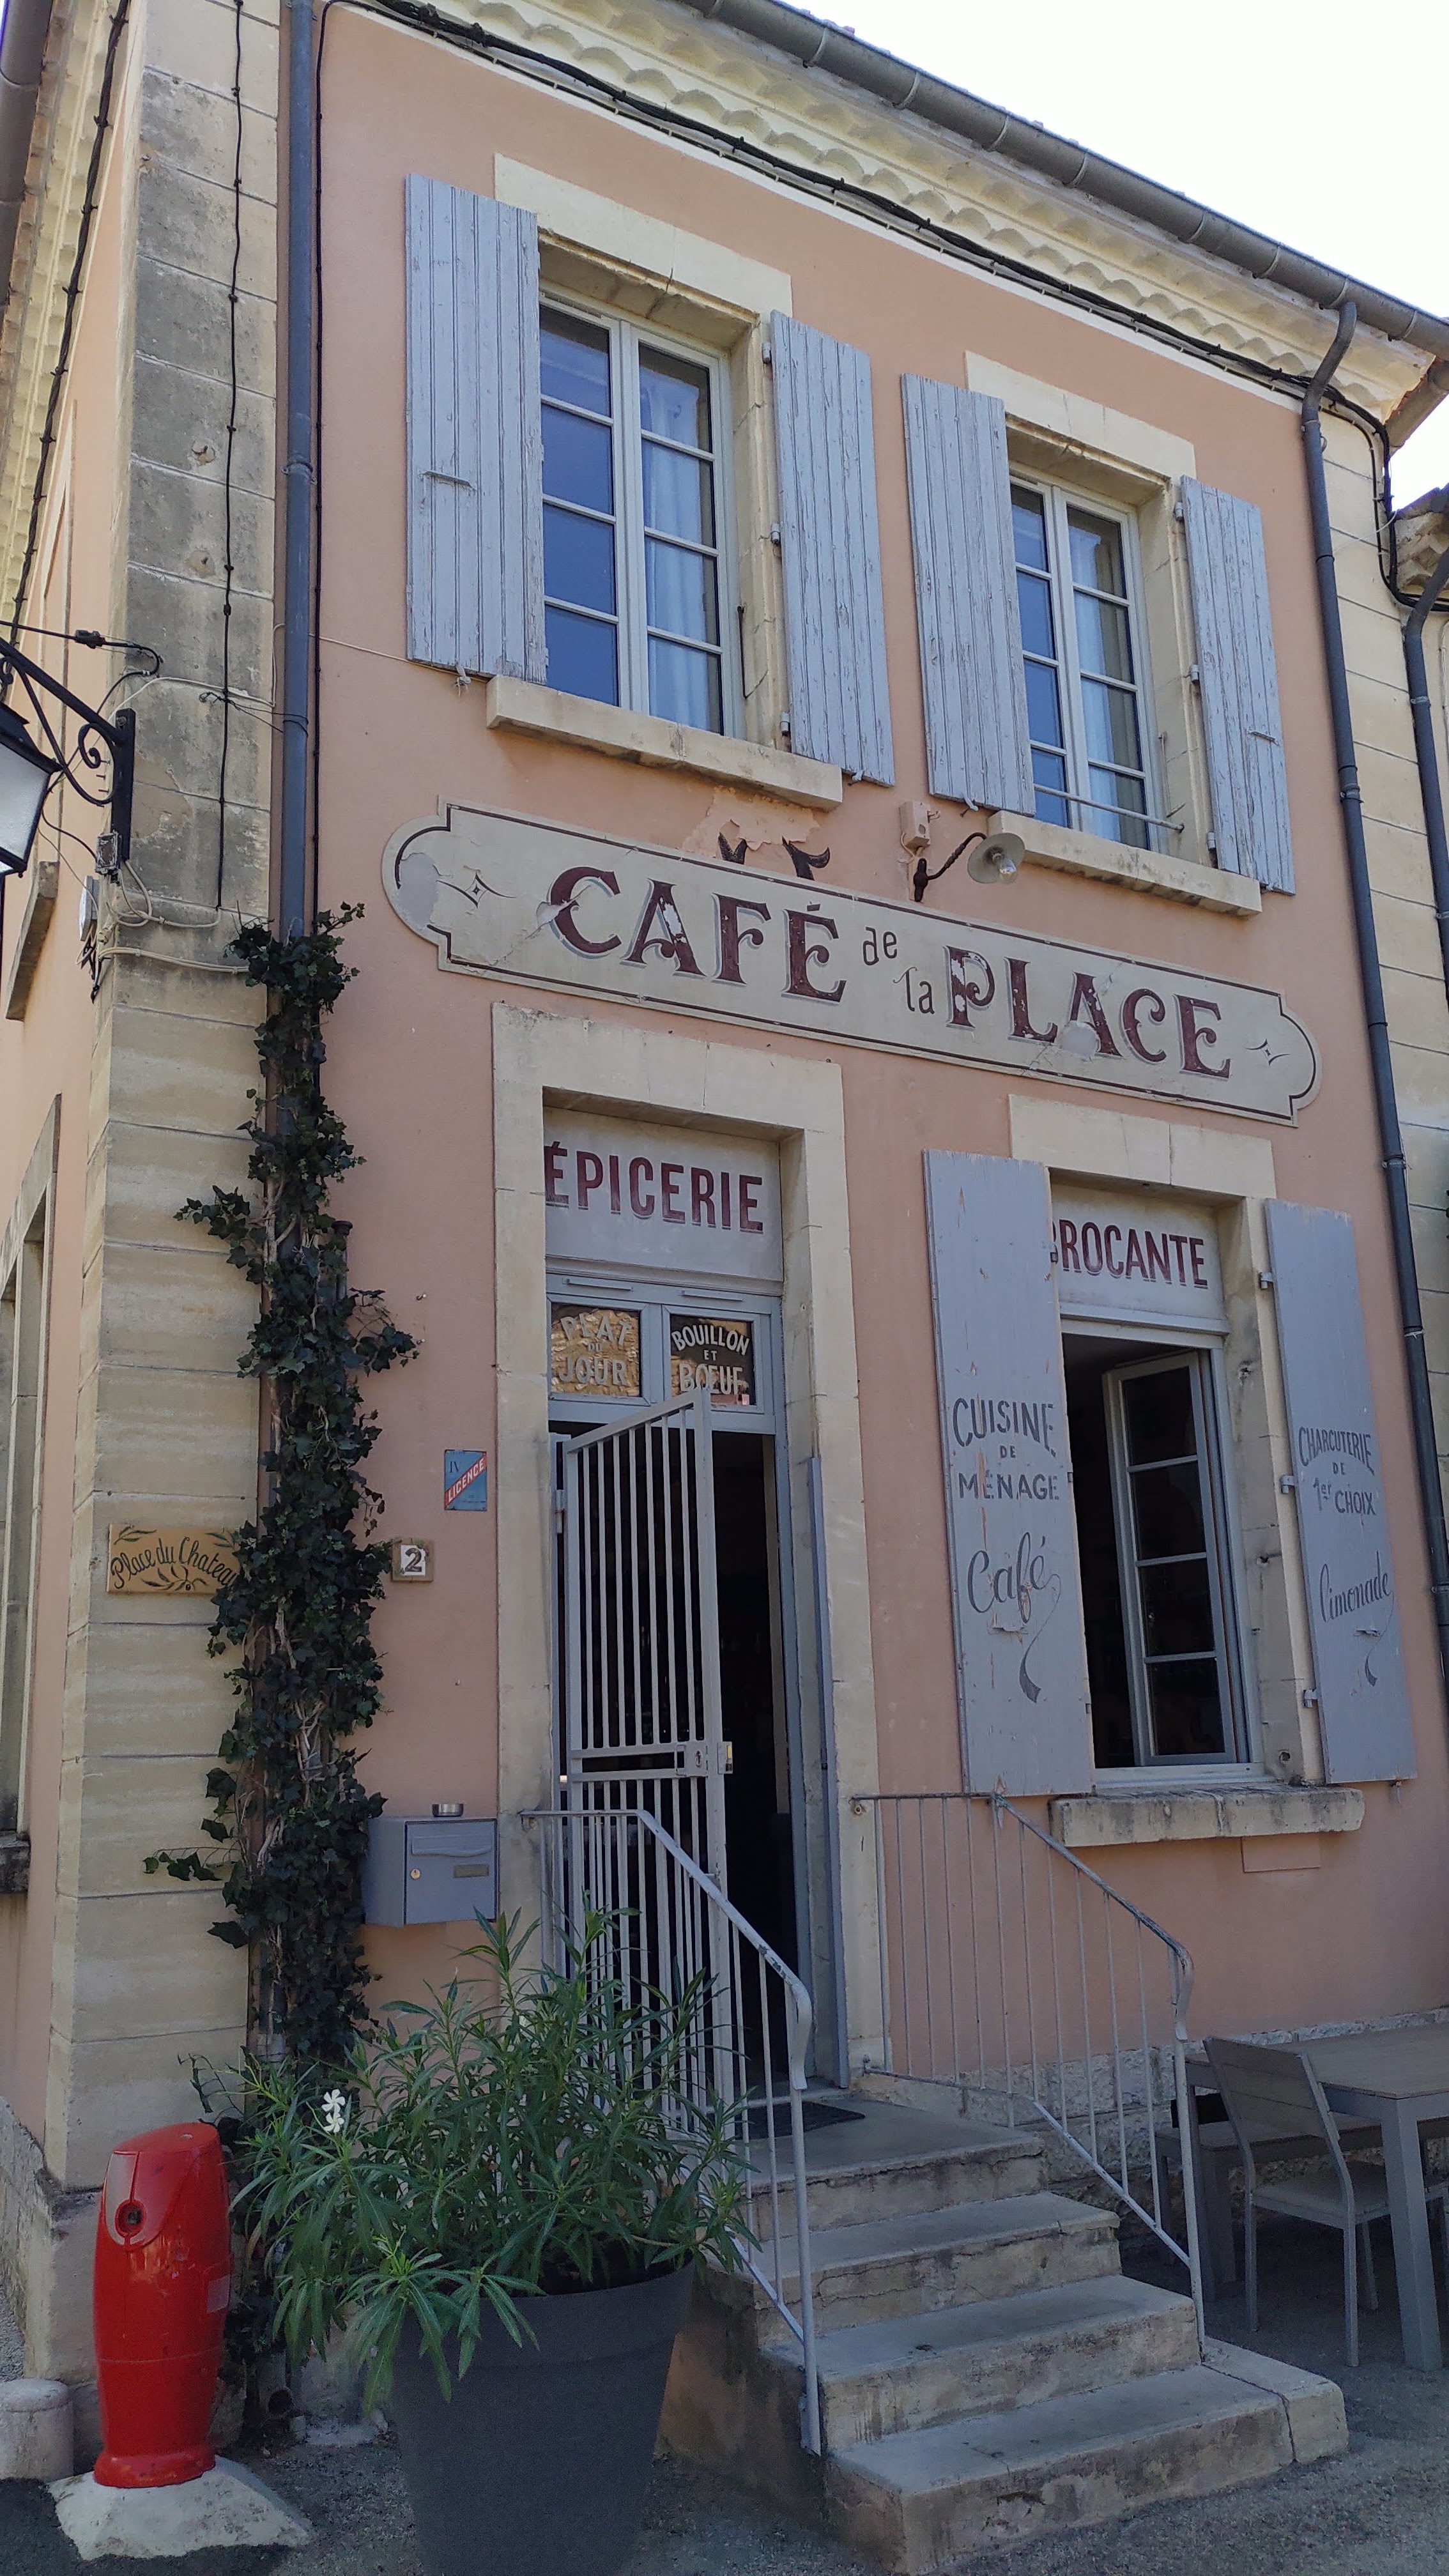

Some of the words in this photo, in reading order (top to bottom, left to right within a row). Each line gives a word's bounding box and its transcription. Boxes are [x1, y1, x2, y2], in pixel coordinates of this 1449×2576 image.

[545, 866, 847, 1004] CAFÉ
[862, 926, 898, 966] de
[893, 967, 935, 1015] la
[945, 946, 1231, 1080] PLACE
[544, 1140, 763, 1234] ÉPICERIE
[1051, 1219, 1209, 1289] ROCANTE
[560, 1312, 632, 1346] PLAT
[671, 1324, 749, 1356] BOUILLON
[588, 1342, 602, 1353] DU
[704, 1350, 717, 1360] ET
[558, 1355, 631, 1386] JOUR
[953, 1398, 1055, 1457] CUISINE
[1000, 1445, 1016, 1458] DE
[1299, 1427, 1374, 1476] CHARCUTERIE
[1333, 1462, 1345, 1475] DE
[448, 1457, 484, 1503] LICENCE
[1335, 1490, 1376, 1515] CHOIX
[111, 1549, 157, 1589] Place
[157, 1538, 176, 1565] du
[405, 1547, 422, 1572] 2
[967, 1531, 1053, 1623] Café
